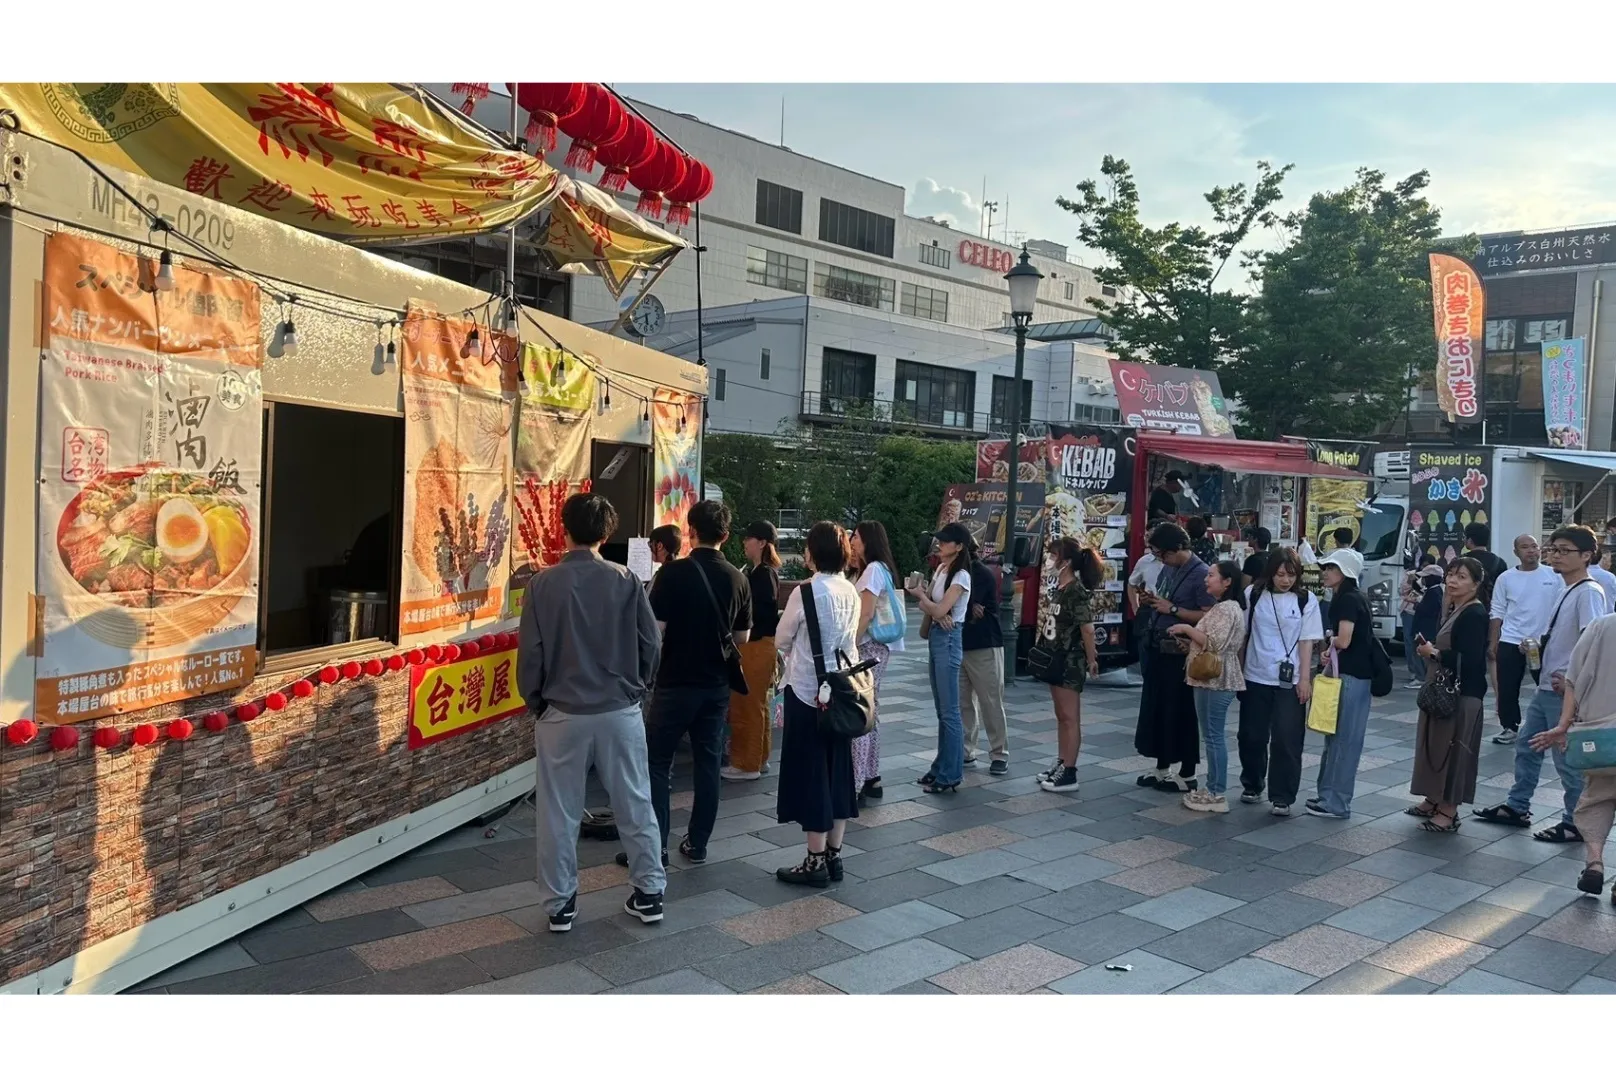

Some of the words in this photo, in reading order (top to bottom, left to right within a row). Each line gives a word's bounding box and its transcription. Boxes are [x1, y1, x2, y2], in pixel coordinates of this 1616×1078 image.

[959, 239, 1013, 273] CELEO
[1487, 248, 1593, 268] 仕込みのおいしさ
[64, 350, 123, 367] Taiwanese
[64, 367, 91, 379] Pork
[93, 370, 118, 382] Rice
[1139, 378, 1189, 406] ケバブ
[1175, 411, 1200, 421] KEBAB
[1061, 444, 1116, 479] KEBAB
[1419, 452, 1462, 466] Shaved
[1464, 453, 1482, 466] ice
[1428, 468, 1488, 504] かき氷
